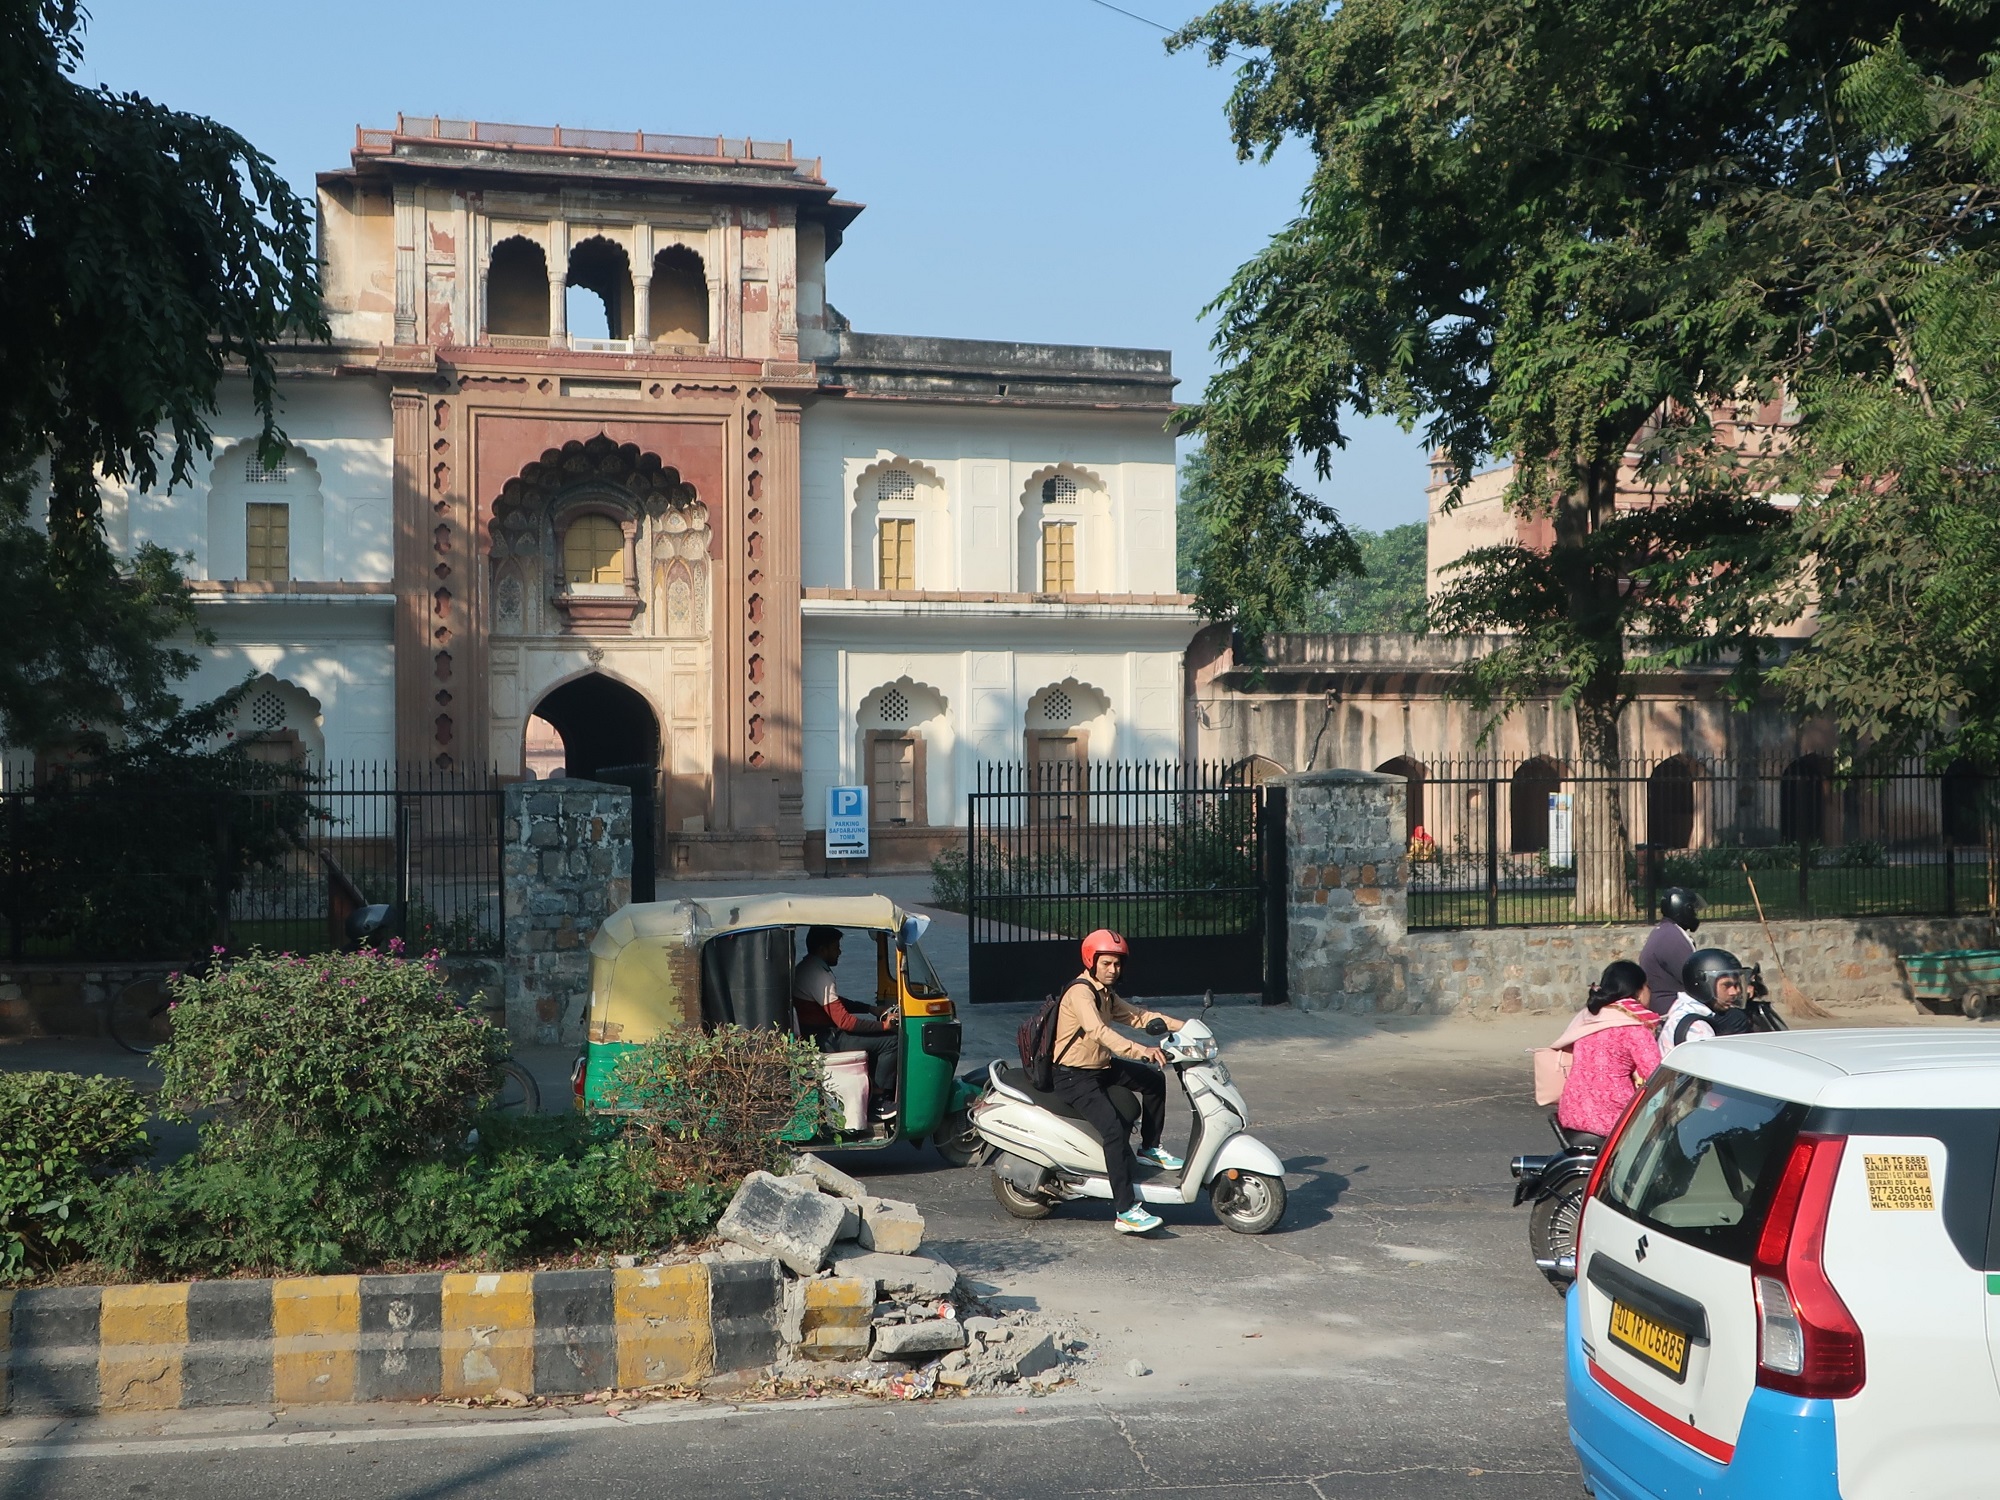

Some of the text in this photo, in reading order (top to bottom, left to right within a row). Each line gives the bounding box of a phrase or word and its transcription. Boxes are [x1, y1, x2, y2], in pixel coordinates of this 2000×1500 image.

[838, 791, 858, 815] P
[1864, 1157, 1876, 1165] DL
[1878, 1157, 1890, 1165] 1R
[1905, 1157, 1926, 1165] 6885
[1866, 1164, 1892, 1172] SANJAY
[1869, 1179, 1894, 1187] BURARI
[1869, 1186, 1932, 1195] 9773501614
[1871, 1194, 1932, 1202] HL 42400400
